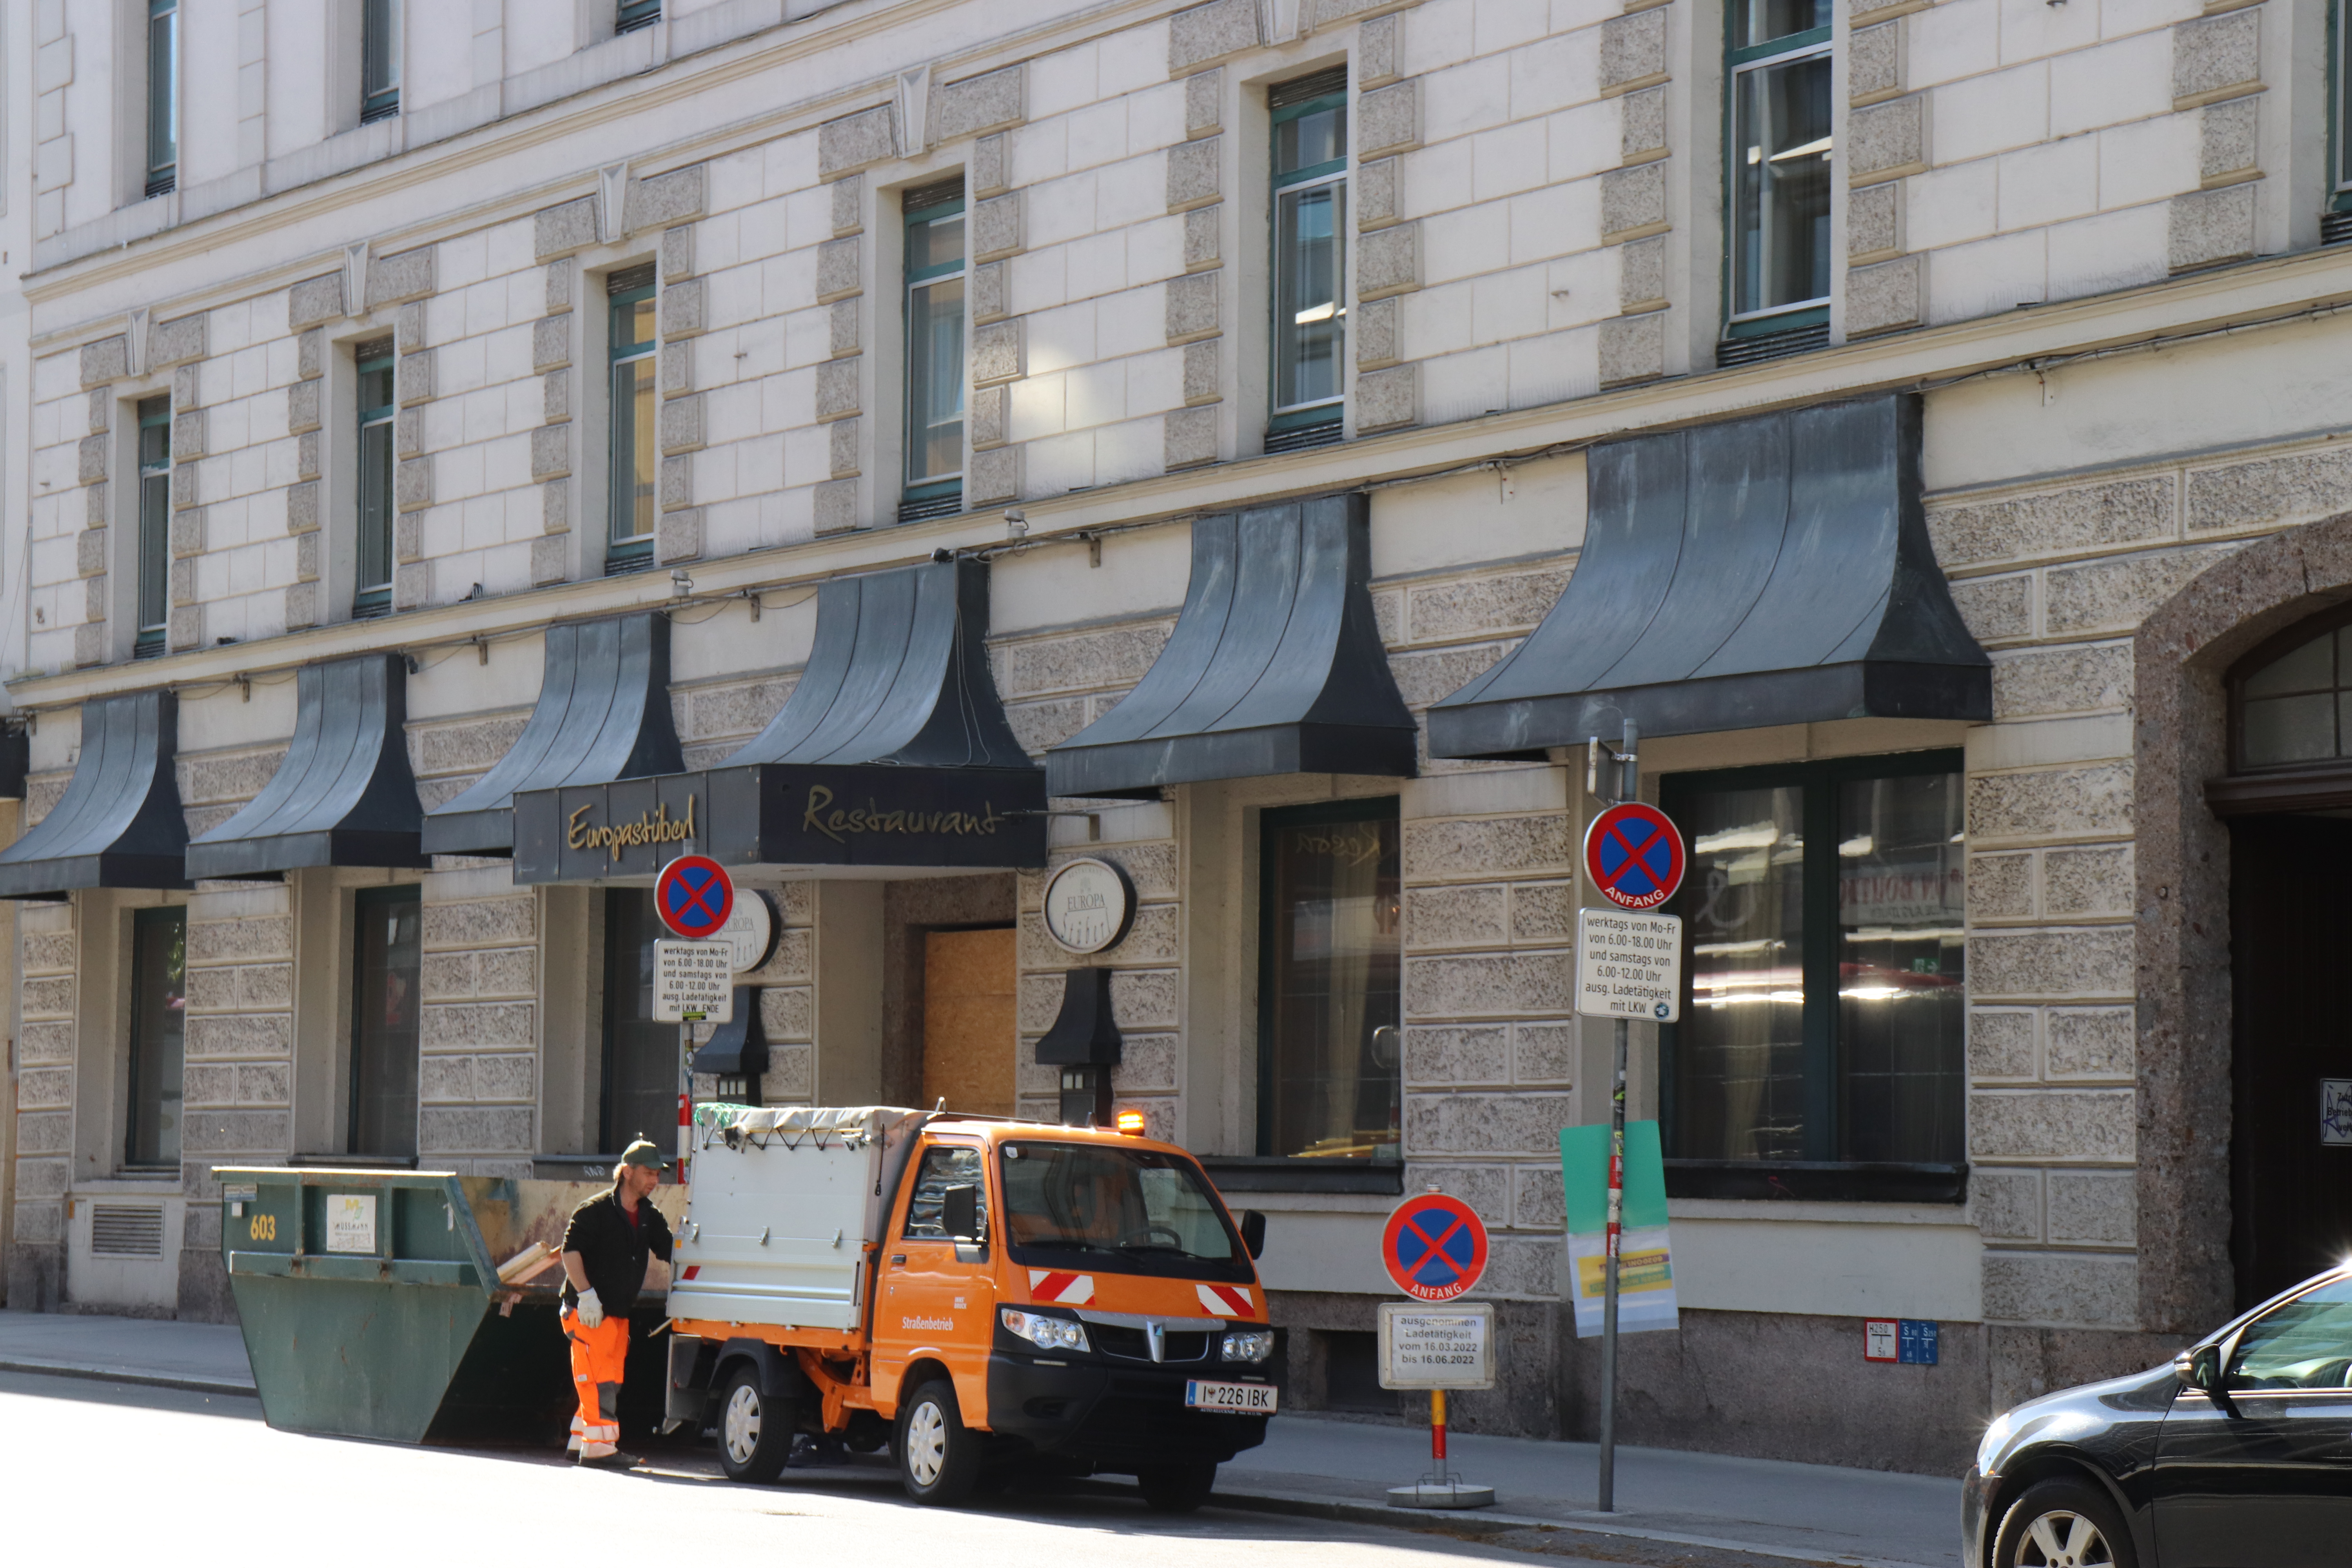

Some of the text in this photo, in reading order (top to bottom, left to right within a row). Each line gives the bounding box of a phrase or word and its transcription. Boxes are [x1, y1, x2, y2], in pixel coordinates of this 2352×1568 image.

[803, 784, 1005, 844] Restaurant
[568, 793, 695, 862] Europastüberl
[1067, 893, 1105, 910] EUROPA
[1605, 886, 1664, 907] ANFANG
[1588, 917, 1676, 934] werktags von Mo-Fr
[1590, 934, 1605, 944] von
[1657, 938, 1672, 950] Uhr
[664, 947, 694, 957] werktags
[710, 947, 728, 956] Mo-Fr
[1590, 950, 1670, 966] und samstags von
[716, 960, 728, 968] Uhr
[664, 969, 676, 977] und
[679, 971, 711, 980] samstags
[1646, 970, 1661, 982] Uhr
[709, 982, 720, 991] Uhr
[1586, 983, 1671, 1000] ausg. Ladetätigkeit
[682, 1004, 697, 1012] LKW
[702, 1004, 719, 1013] ENDE
[1611, 1000, 1646, 1013] mit LKW
[250, 1215, 275, 1241] 603
[1411, 1283, 1462, 1298] ANFANG
[902, 1316, 953, 1331] Straßenbetrieb
[1401, 1318, 1476, 1327] ausgenommen
[1406, 1329, 1471, 1340] Ladetätigkeit
[1425, 1343, 1477, 1352] 16.03.2022
[1402, 1354, 1474, 1364] bis 16.06.2022
[1218, 1387, 1243, 1405] 226
[1247, 1389, 1269, 1407] IBK
